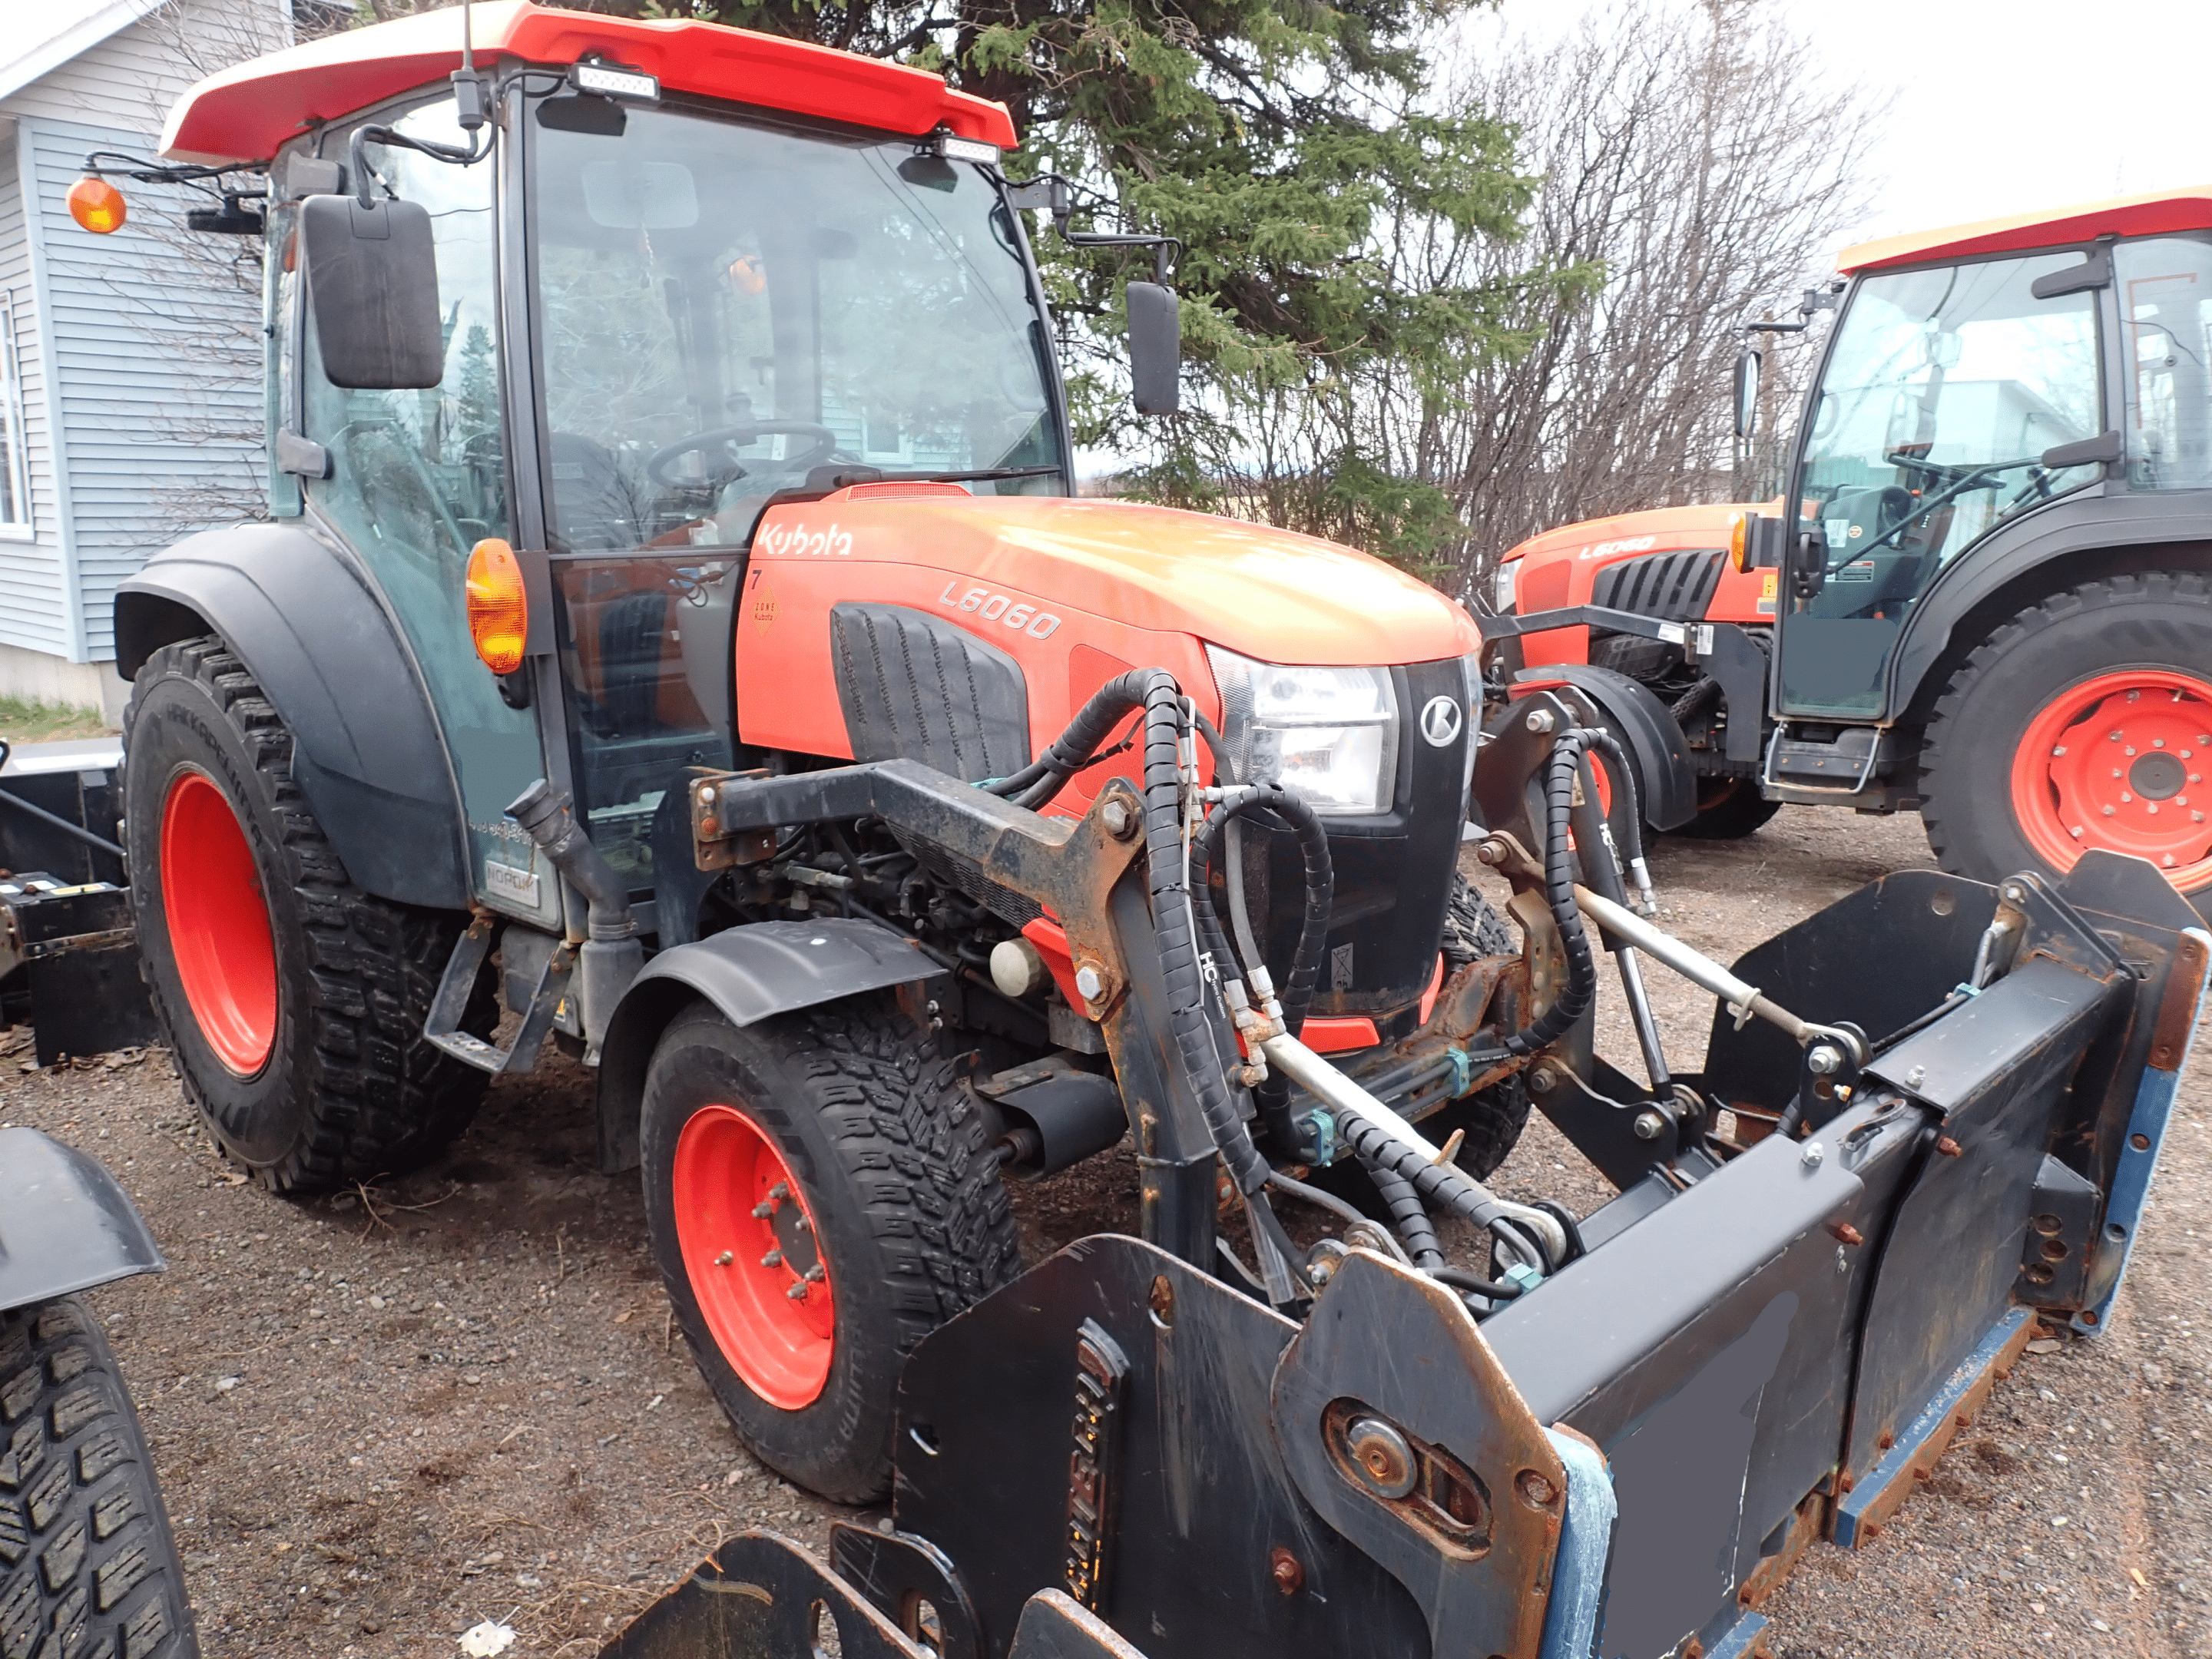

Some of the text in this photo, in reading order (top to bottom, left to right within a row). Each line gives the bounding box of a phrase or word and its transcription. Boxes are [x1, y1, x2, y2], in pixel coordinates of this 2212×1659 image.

[757, 523, 853, 556] Kubota
[1579, 536, 1656, 560] L6060
[751, 569, 763, 590] 7
[756, 602, 775, 611] ZONE
[939, 581, 1061, 640] L6060
[1199, 951, 1217, 983] HC
[1211, 978, 1227, 1019] Hydro Custom
